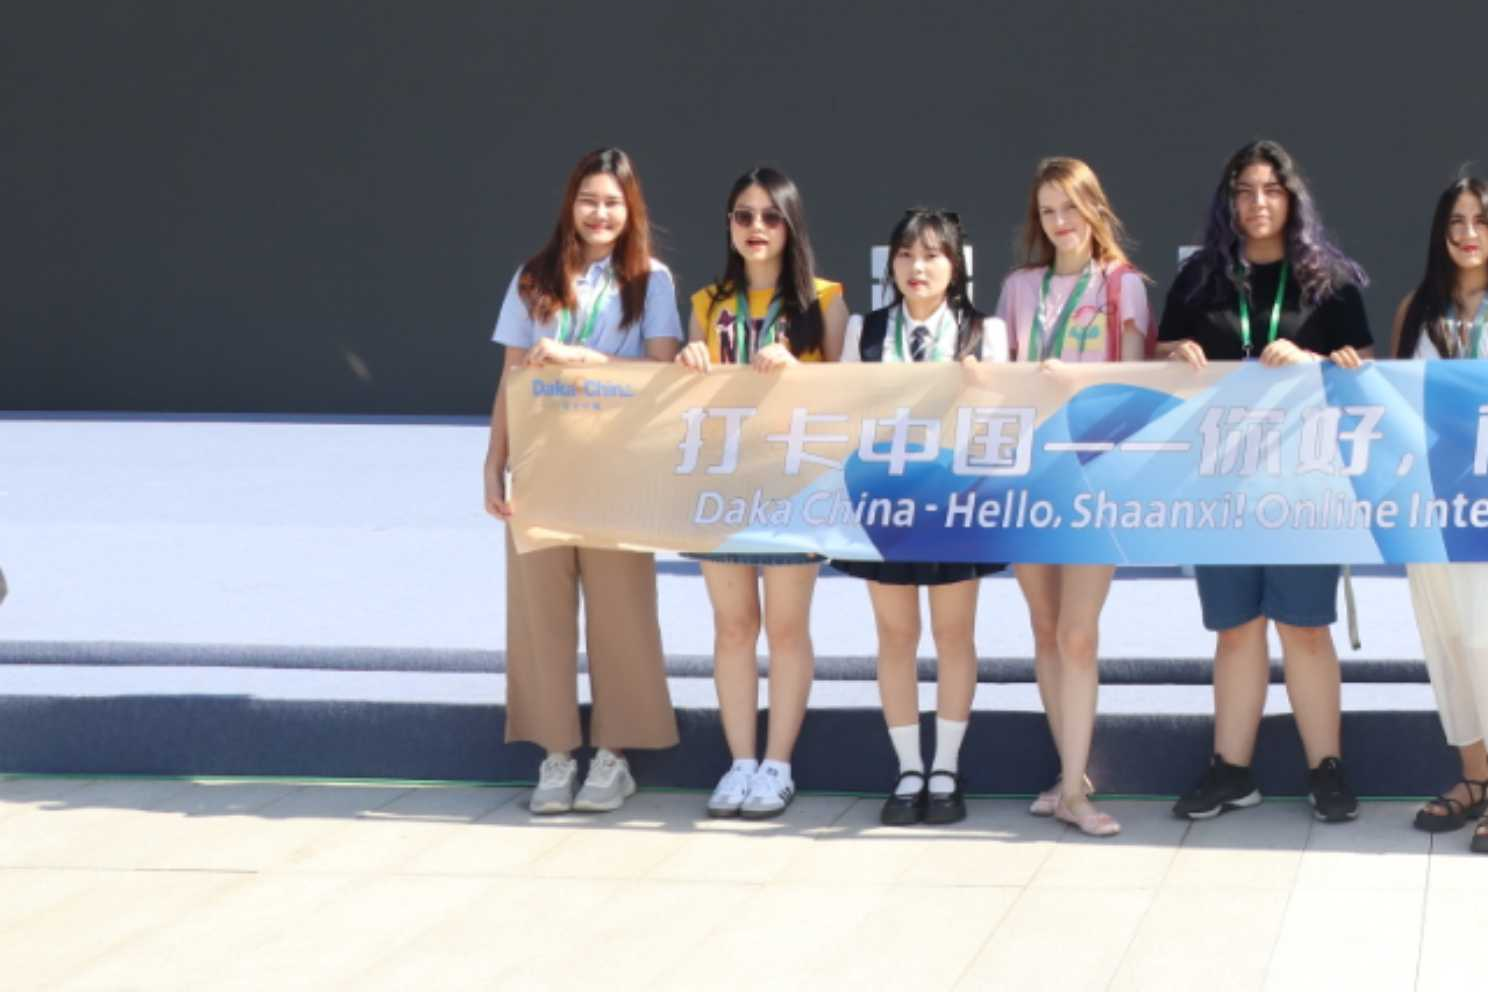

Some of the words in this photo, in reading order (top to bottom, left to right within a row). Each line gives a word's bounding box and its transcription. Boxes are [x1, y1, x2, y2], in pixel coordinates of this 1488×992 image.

[694, 488, 792, 526] Daka
[801, 488, 915, 527] China
[945, 489, 1062, 530] Hello,
[1070, 489, 1247, 530] Shaanxi!
[1255, 488, 1400, 530] Online
